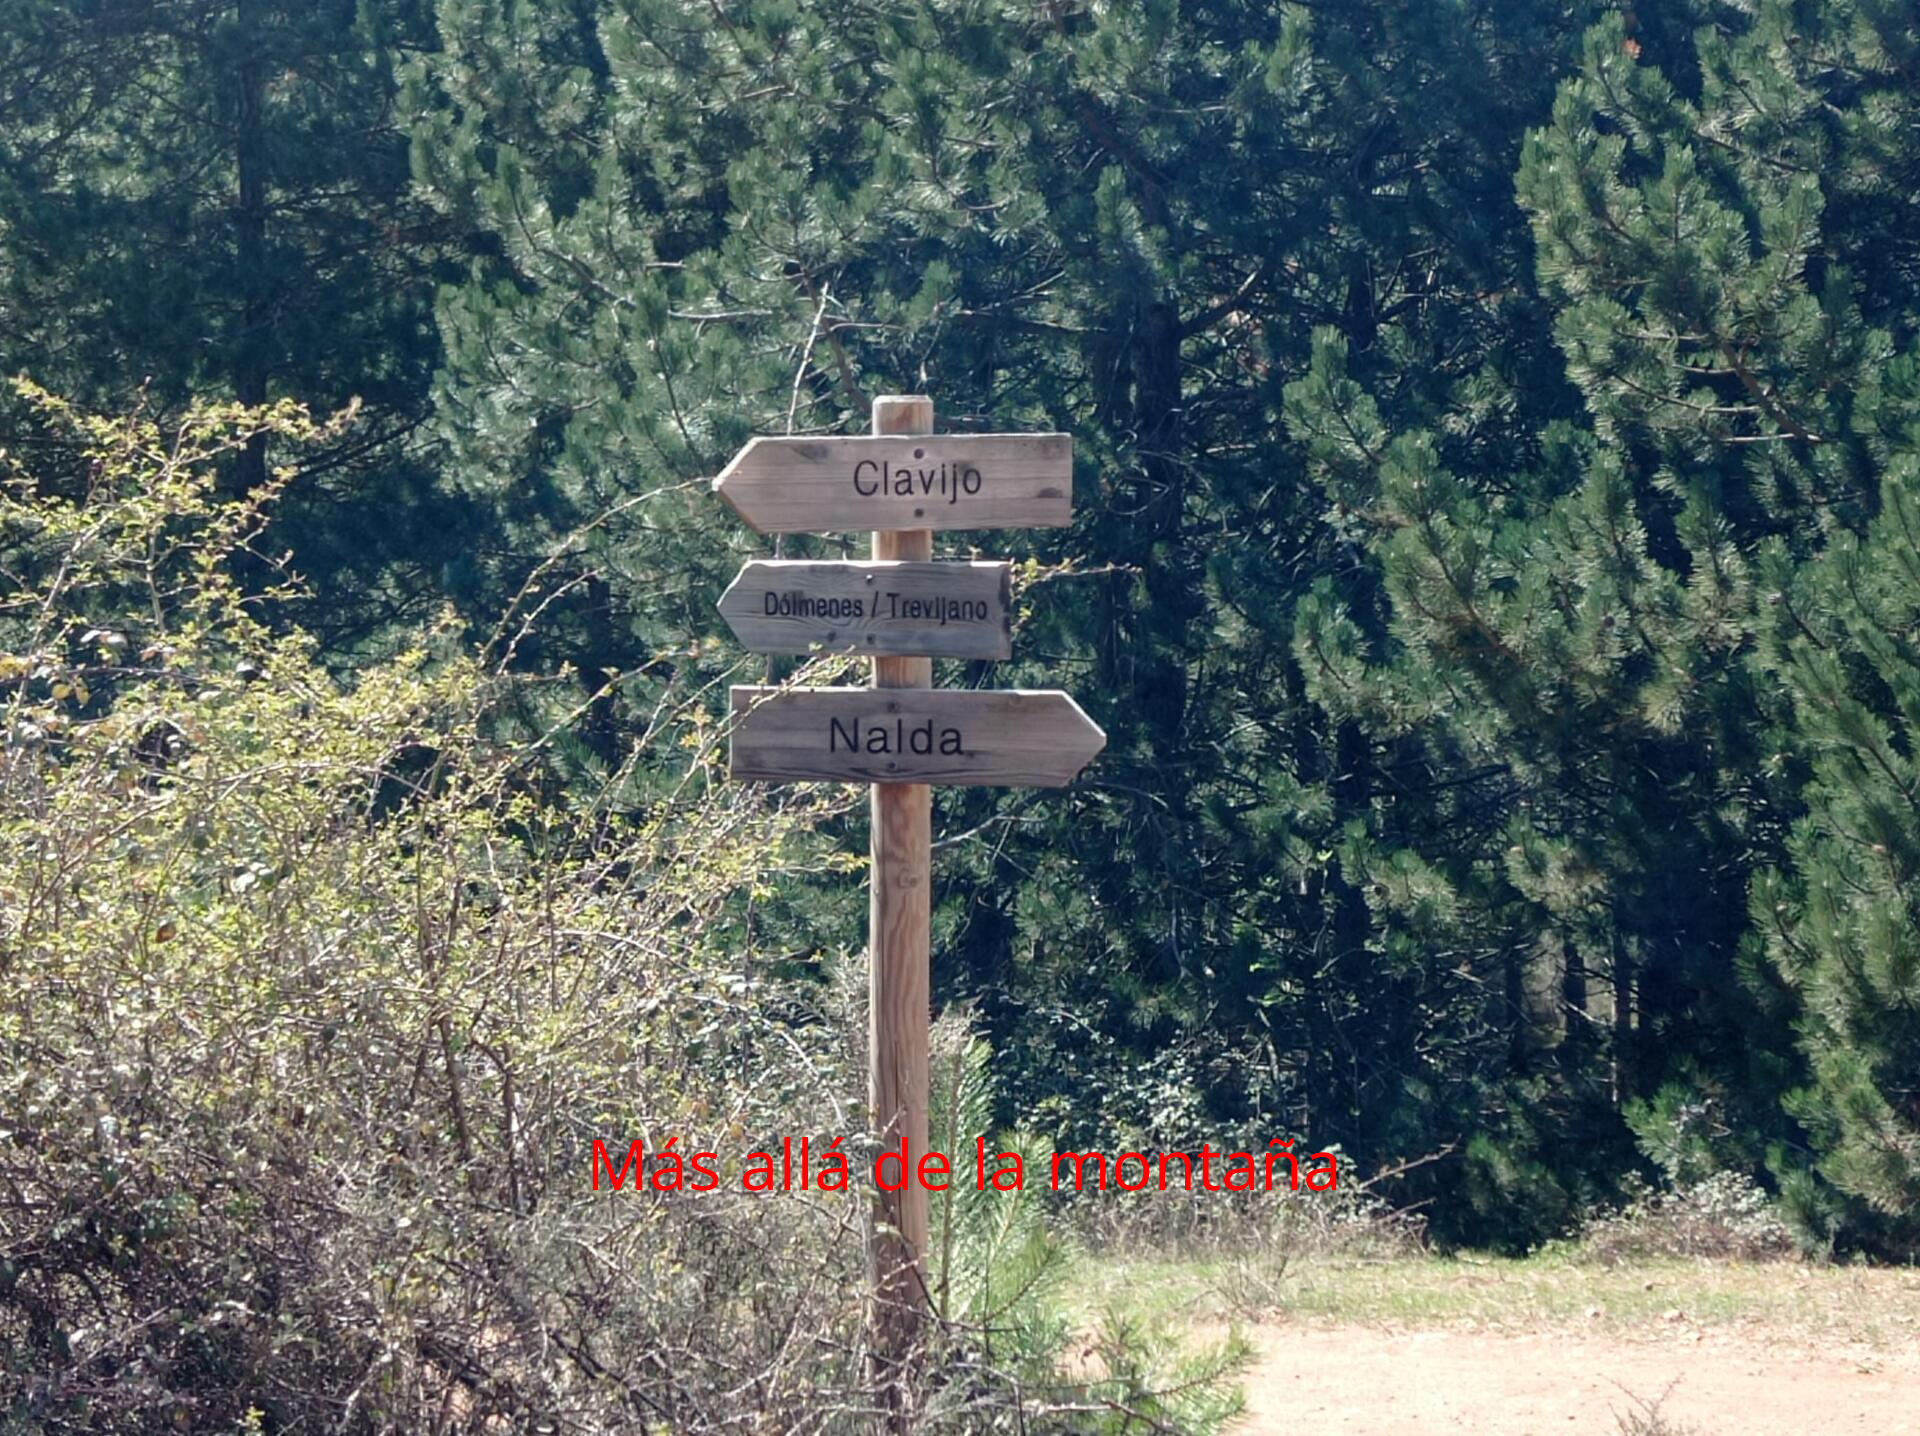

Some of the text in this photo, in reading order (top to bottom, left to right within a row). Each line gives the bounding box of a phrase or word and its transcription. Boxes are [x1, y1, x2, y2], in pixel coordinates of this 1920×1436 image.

[853, 459, 983, 505] Clavijo
[764, 591, 864, 619] Dólmenes
[886, 592, 989, 626] Trevijano
[829, 717, 965, 756] Nalda
